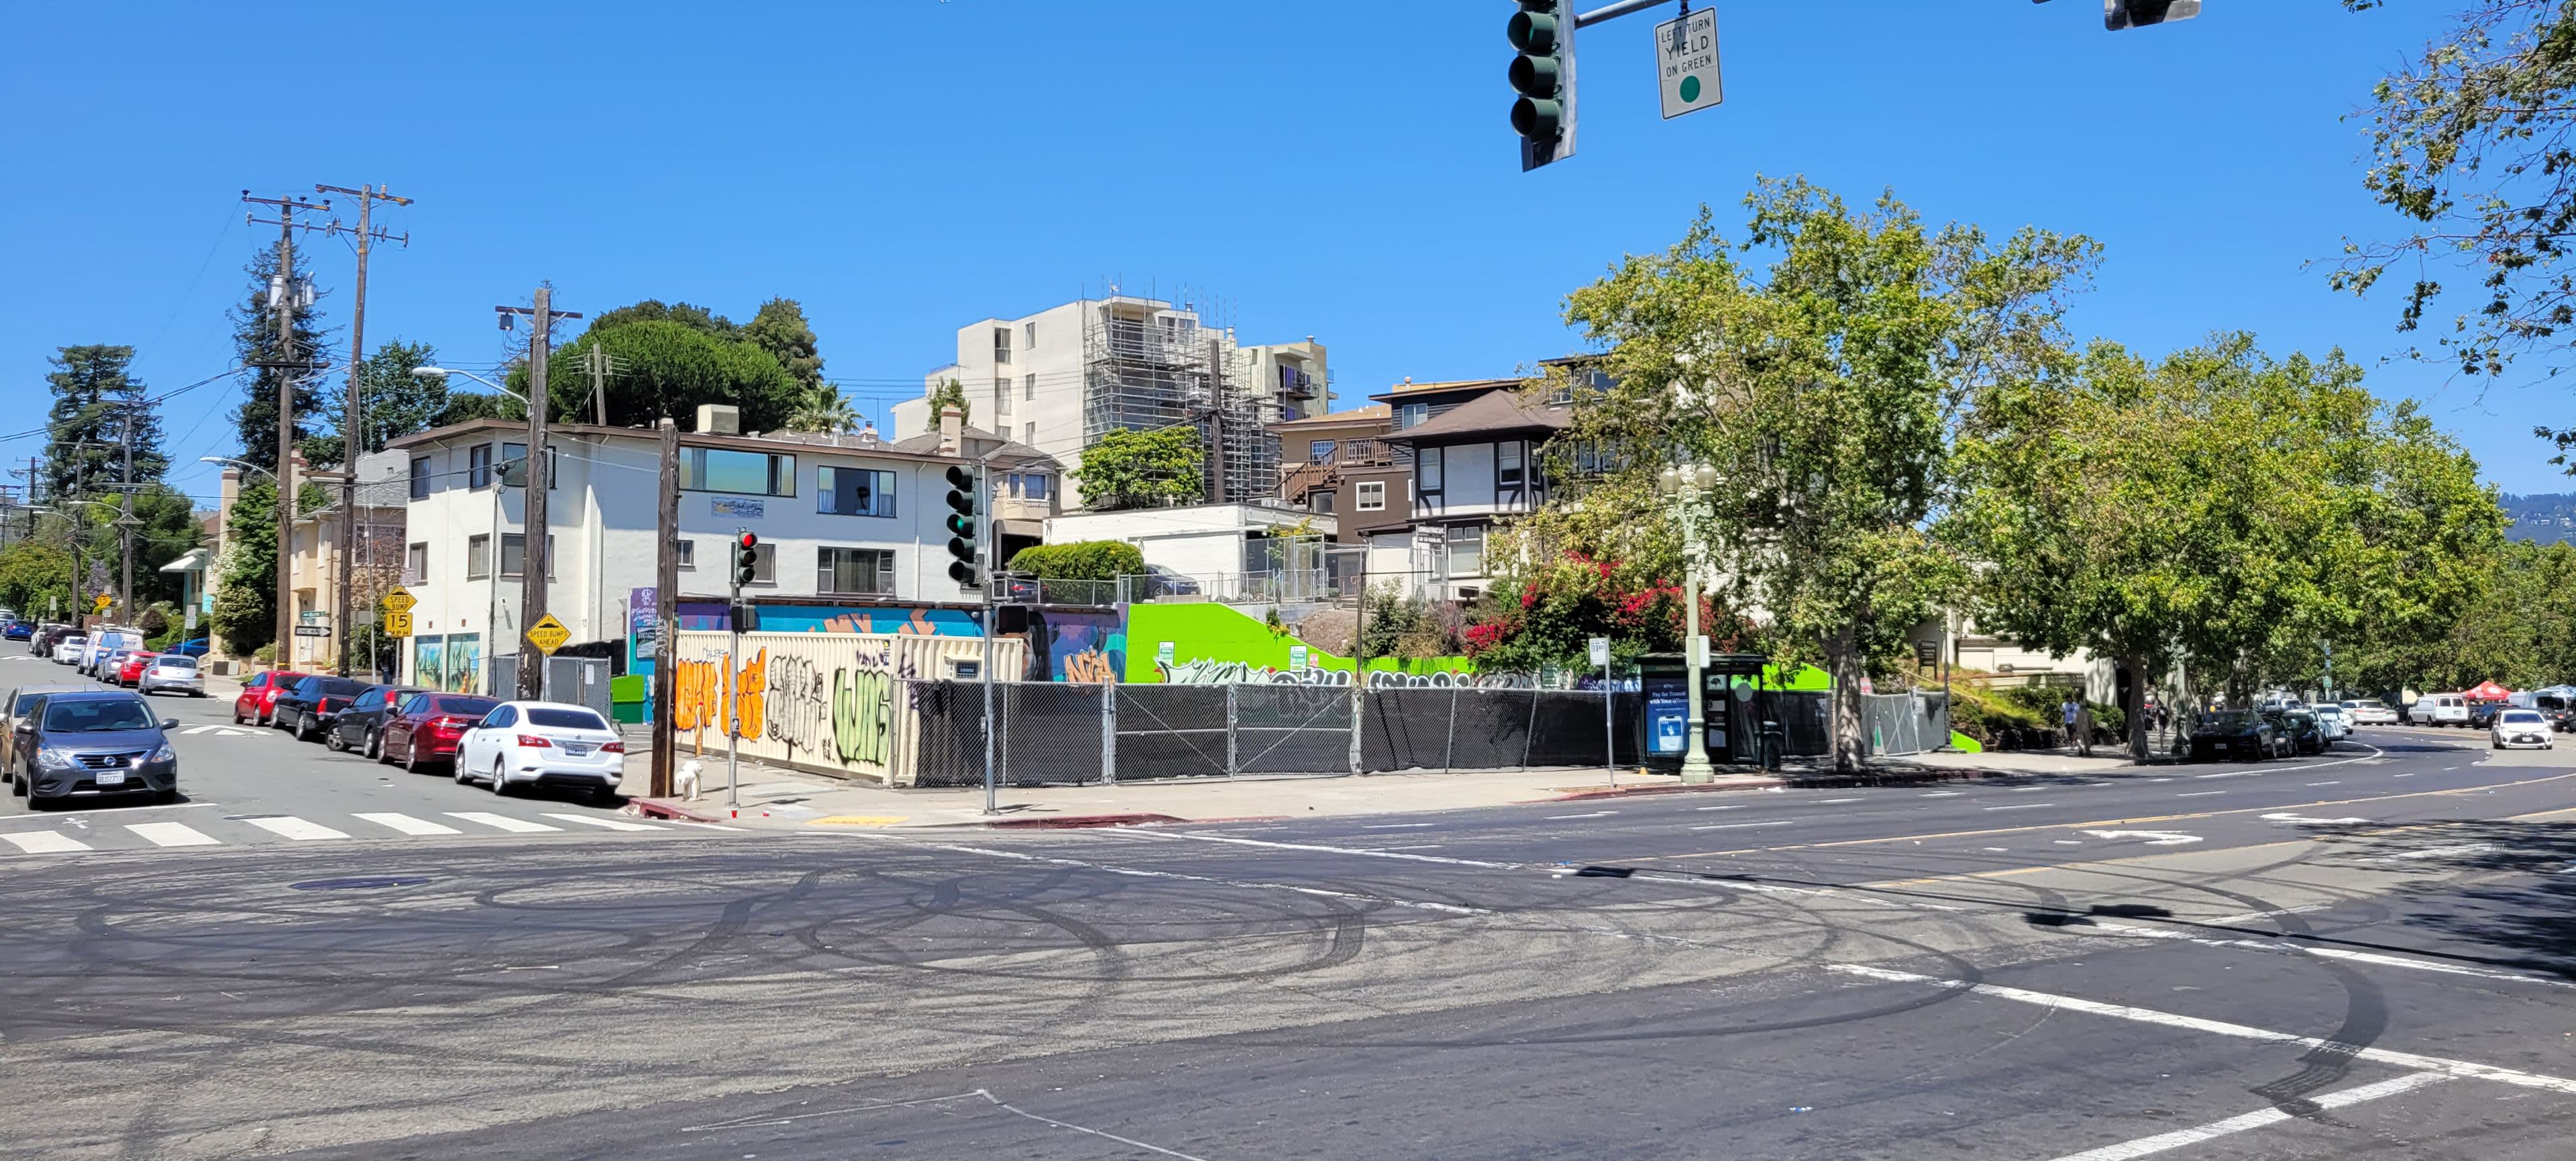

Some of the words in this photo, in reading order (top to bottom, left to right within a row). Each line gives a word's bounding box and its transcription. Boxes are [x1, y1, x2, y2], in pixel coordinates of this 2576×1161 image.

[1661, 26, 1682, 43] LEFT
[1686, 17, 1711, 34] TURN
[1665, 35, 1709, 60] YIELD
[1666, 64, 1678, 78] ON
[1681, 54, 1711, 73] GREEN
[391, 615, 408, 627] 15
